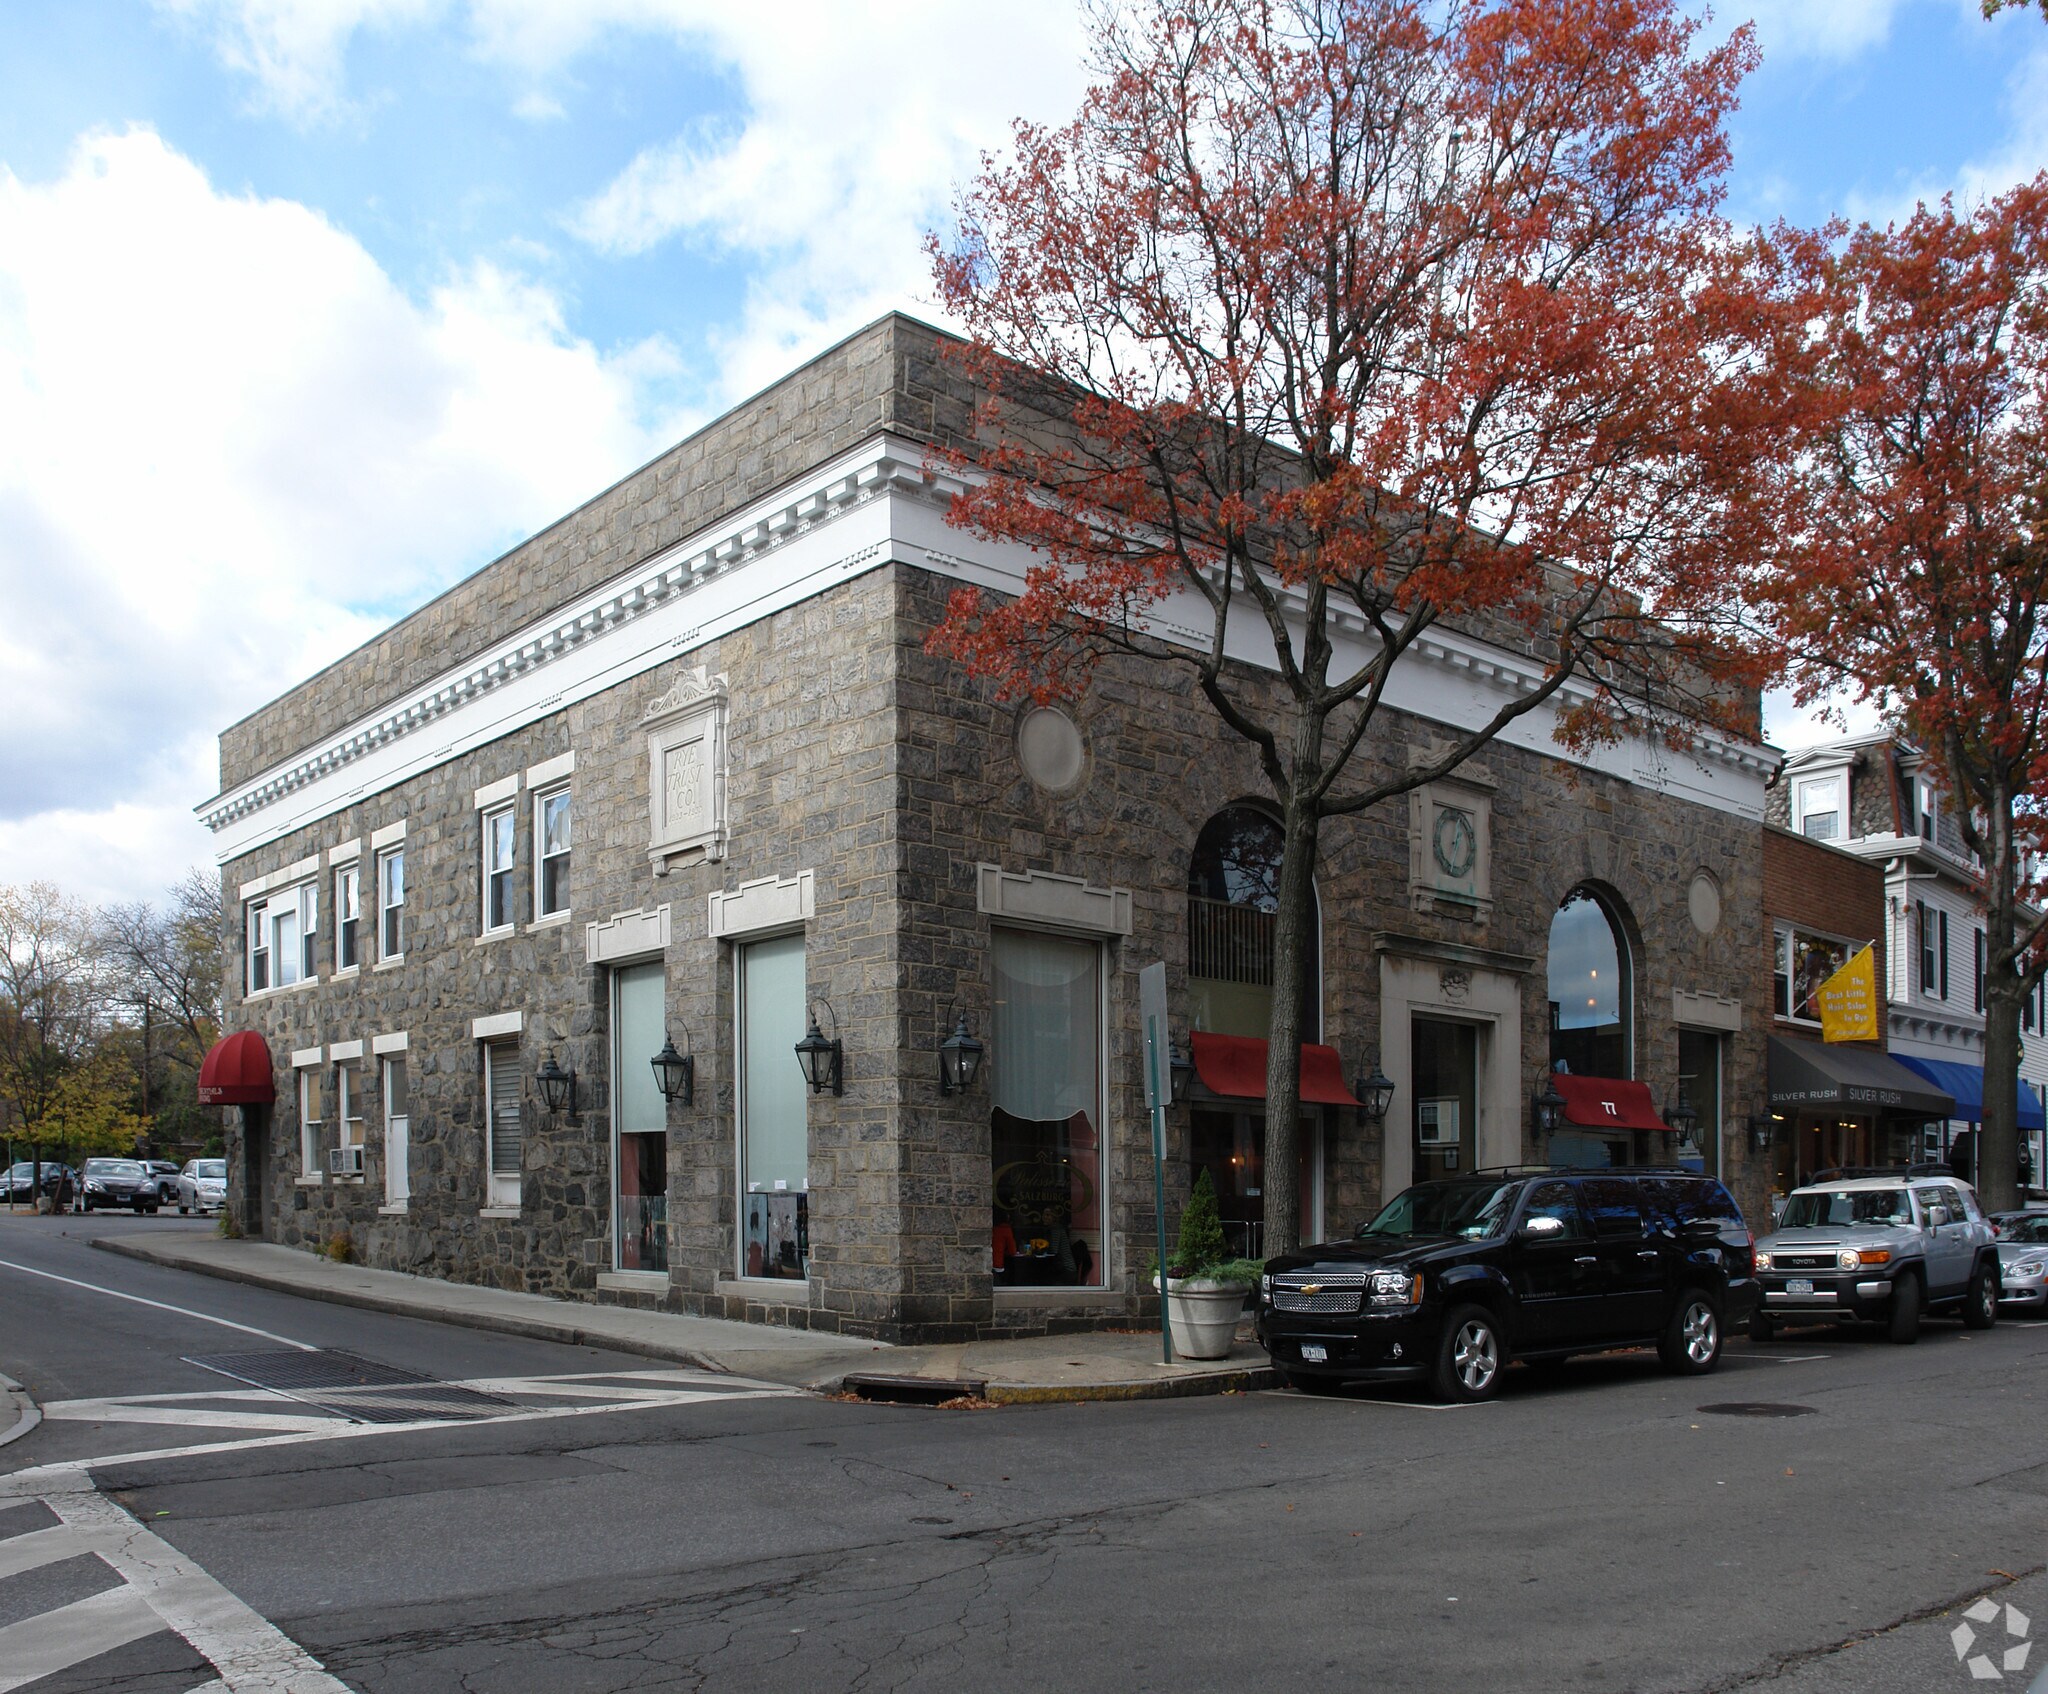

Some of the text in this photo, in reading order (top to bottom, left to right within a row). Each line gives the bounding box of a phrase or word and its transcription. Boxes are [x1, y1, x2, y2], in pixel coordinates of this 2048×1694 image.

[673, 746, 697, 769] RYE
[666, 763, 705, 793] TRUST
[676, 788, 696, 809] CO.
[1851, 976, 1865, 986] The
[1826, 989, 1866, 1000] Best Little
[1847, 1001, 1867, 1011] Salon
[1772, 1089, 1838, 1102] SILVER RUSH
[1849, 1087, 1902, 1104] SILVER RUSH
[1019, 1191, 1064, 1201] SALZBURG
